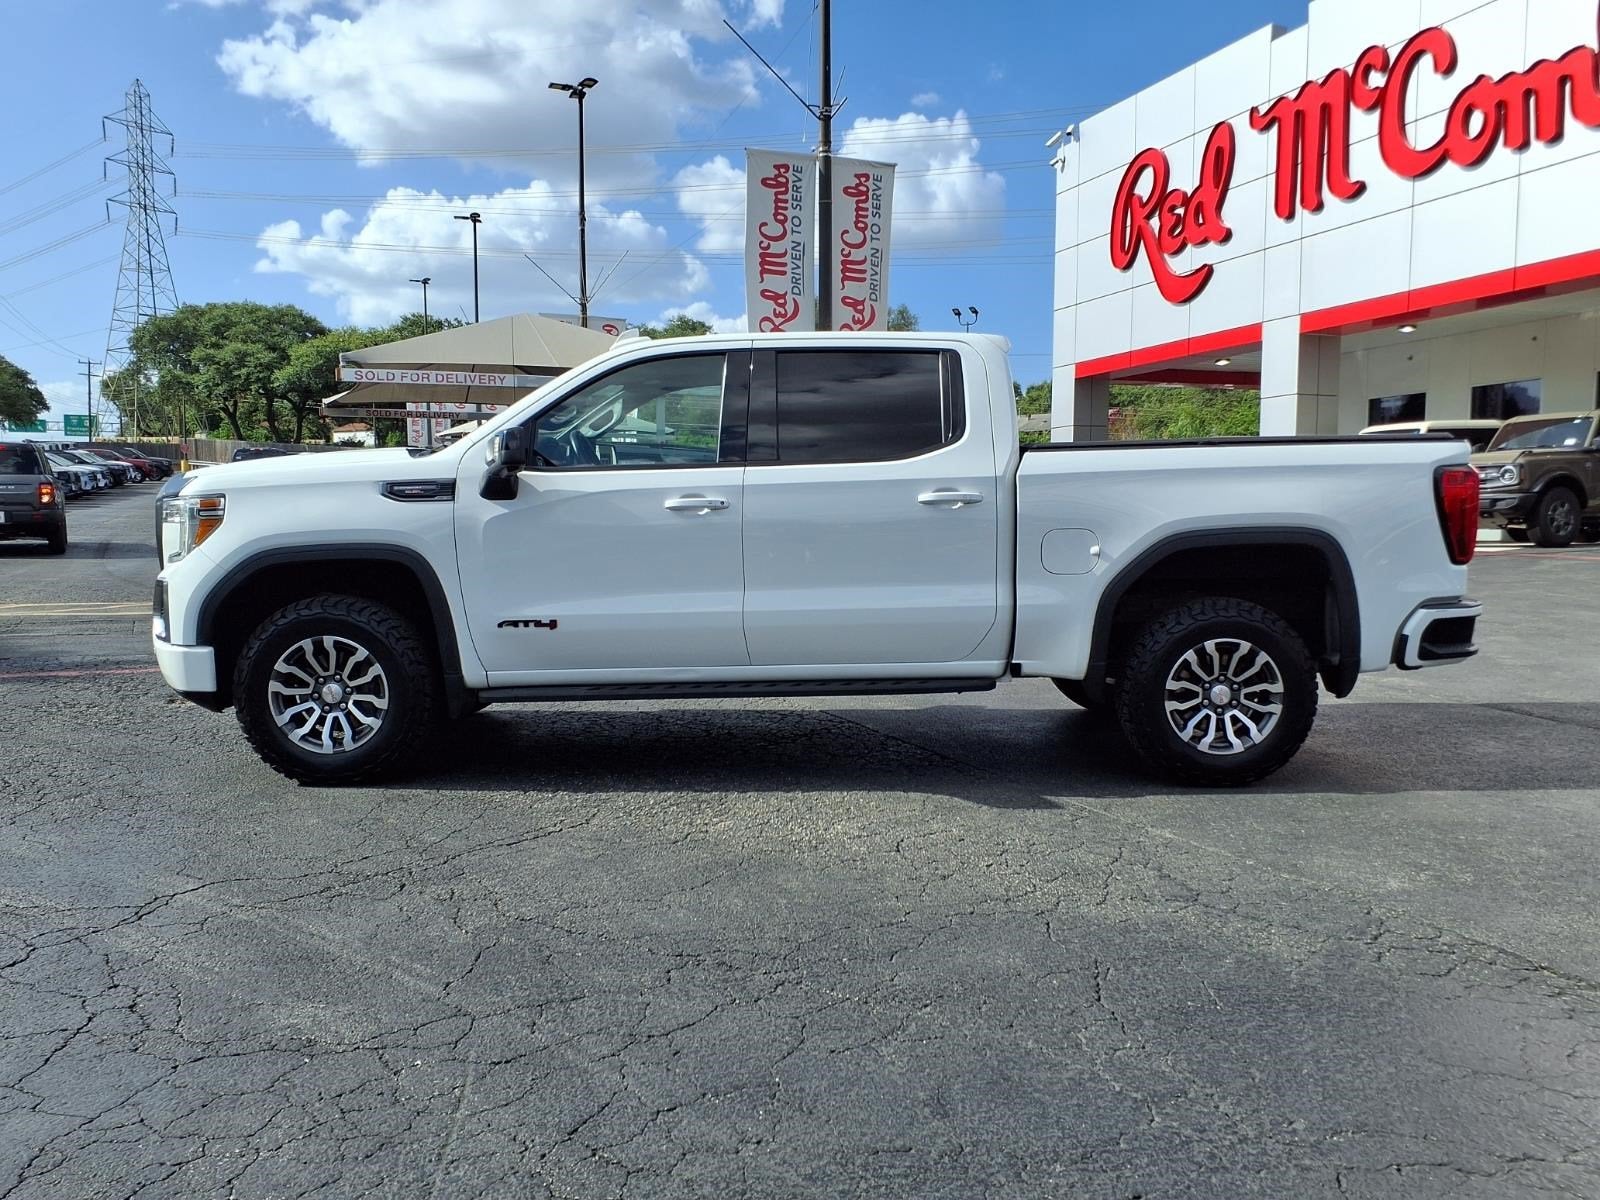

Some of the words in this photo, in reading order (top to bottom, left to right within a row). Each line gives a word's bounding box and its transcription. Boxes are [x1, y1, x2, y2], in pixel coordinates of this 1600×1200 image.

[1110, 121, 1235, 304] Red
[1249, 0, 1600, 222] McCom
[791, 164, 803, 213] SERVE
[871, 173, 883, 221] SERVE
[758, 163, 791, 284] McCombs
[791, 215, 802, 240] TO
[840, 172, 871, 291] McCombs
[870, 222, 881, 243] TO
[791, 241, 802, 296] DRIVEN
[869, 247, 881, 302] DRIVEN
[354, 370, 396, 382] SOLD
[400, 372, 431, 383] FOR
[435, 373, 507, 385] DELIVERY
[365, 409, 391, 418] SOLD
[394, 410, 413, 418] FOR
[415, 411, 461, 419] DELIVERY
[497, 619, 558, 631] AT4
